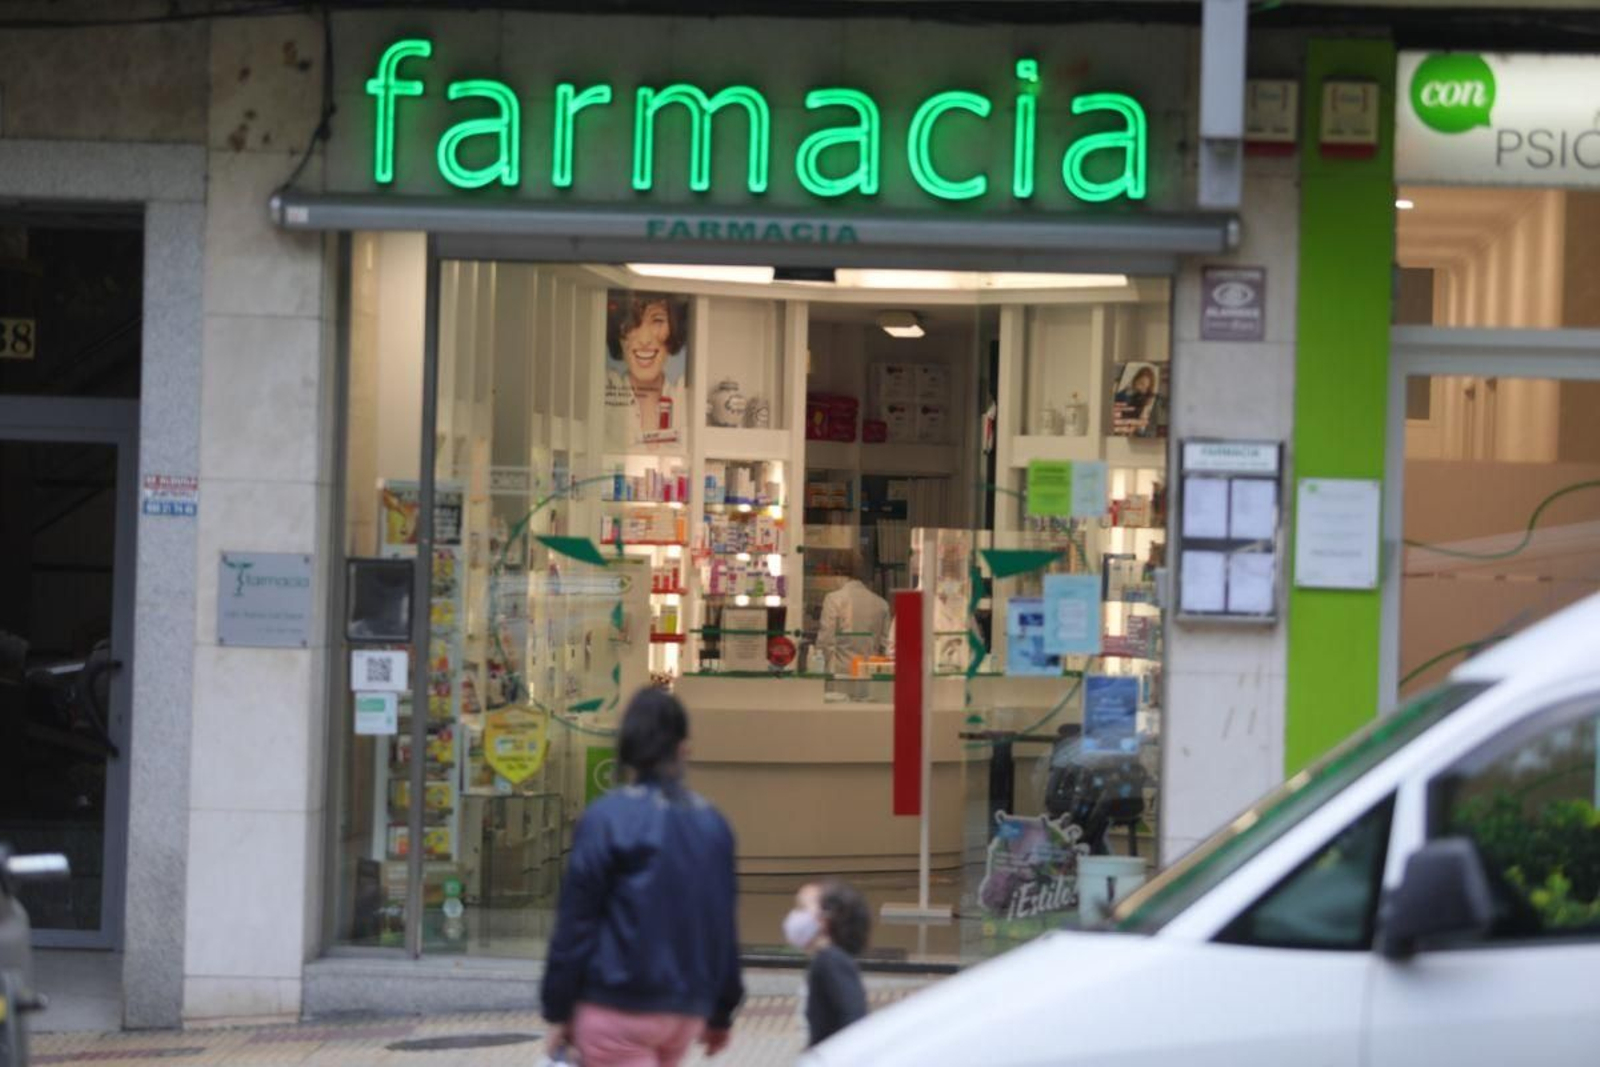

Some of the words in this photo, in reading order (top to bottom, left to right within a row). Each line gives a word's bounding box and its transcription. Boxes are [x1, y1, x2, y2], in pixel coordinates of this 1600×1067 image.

[1421, 80, 1487, 107] con
[366, 39, 1147, 201] farmacia
[647, 218, 858, 243] FARMACIA
